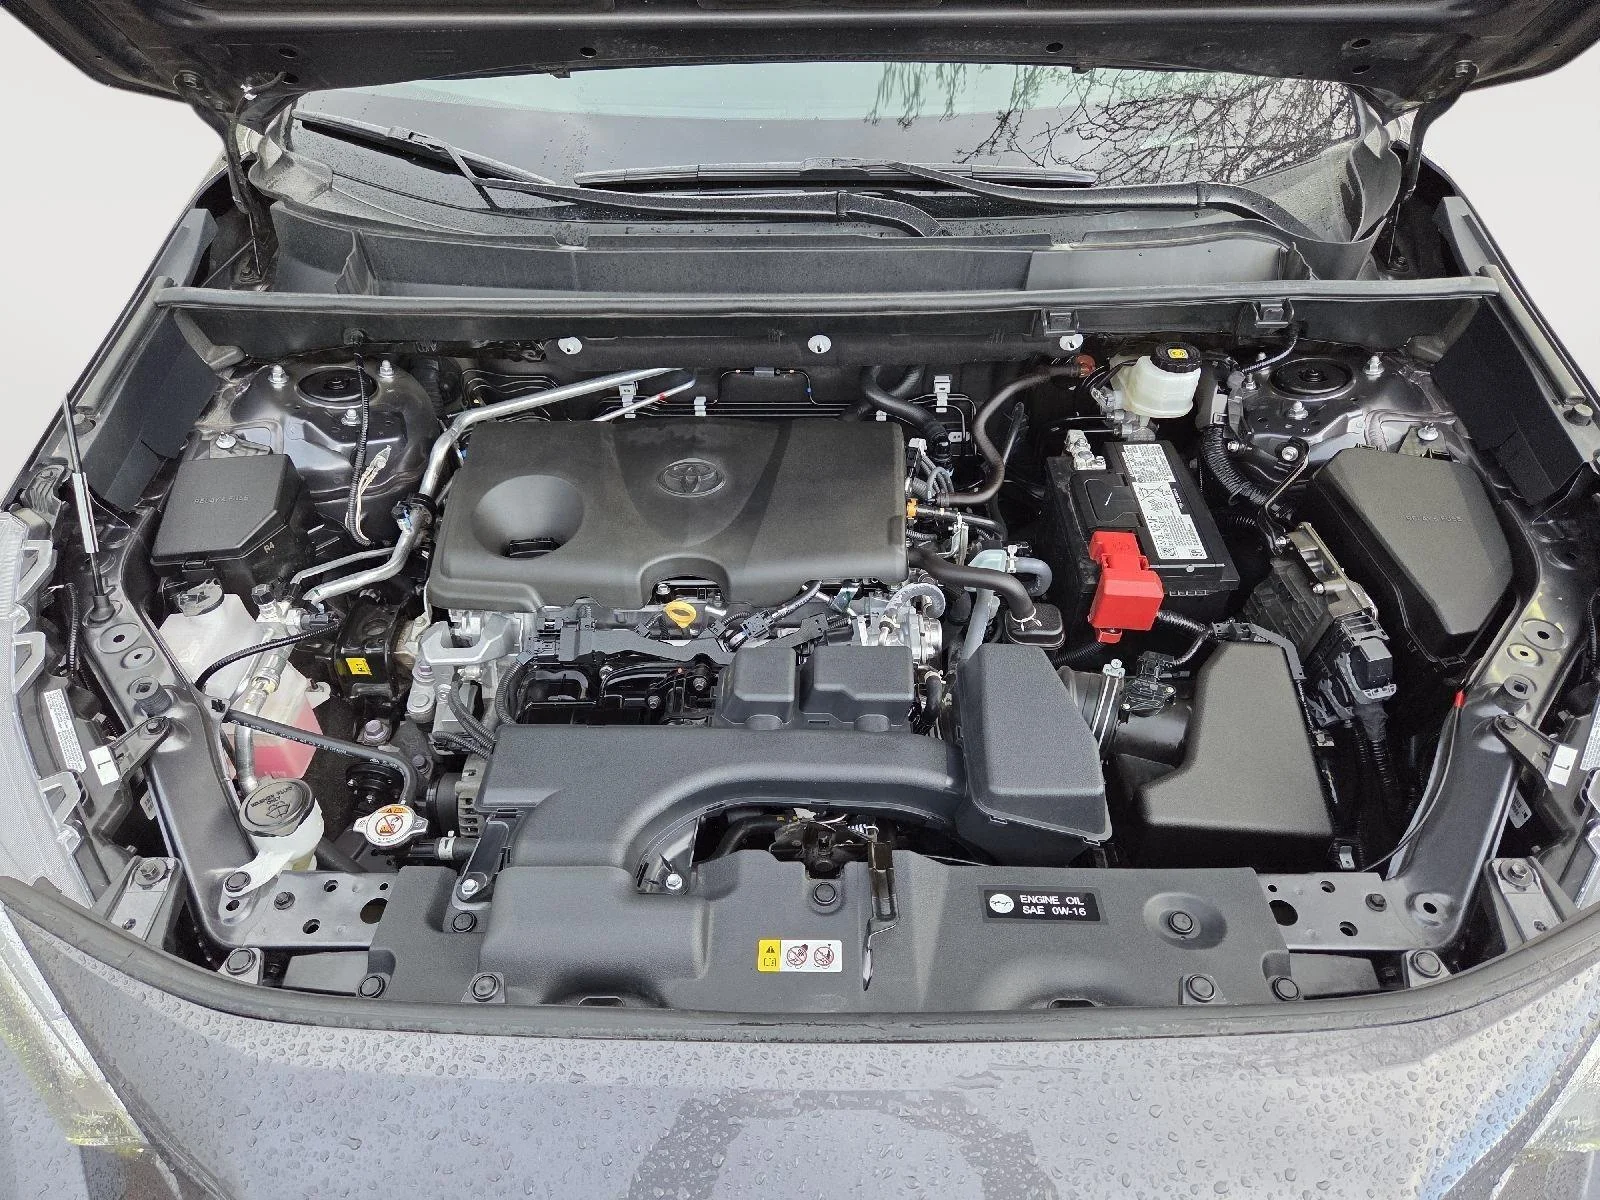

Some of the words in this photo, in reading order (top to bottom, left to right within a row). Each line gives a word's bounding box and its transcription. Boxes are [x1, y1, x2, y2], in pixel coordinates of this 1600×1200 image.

[1019, 894, 1060, 905] ENGINE
[1065, 896, 1085, 906] OIL
[1022, 905, 1046, 915] SAE
[1051, 906, 1087, 917] 0W-16
